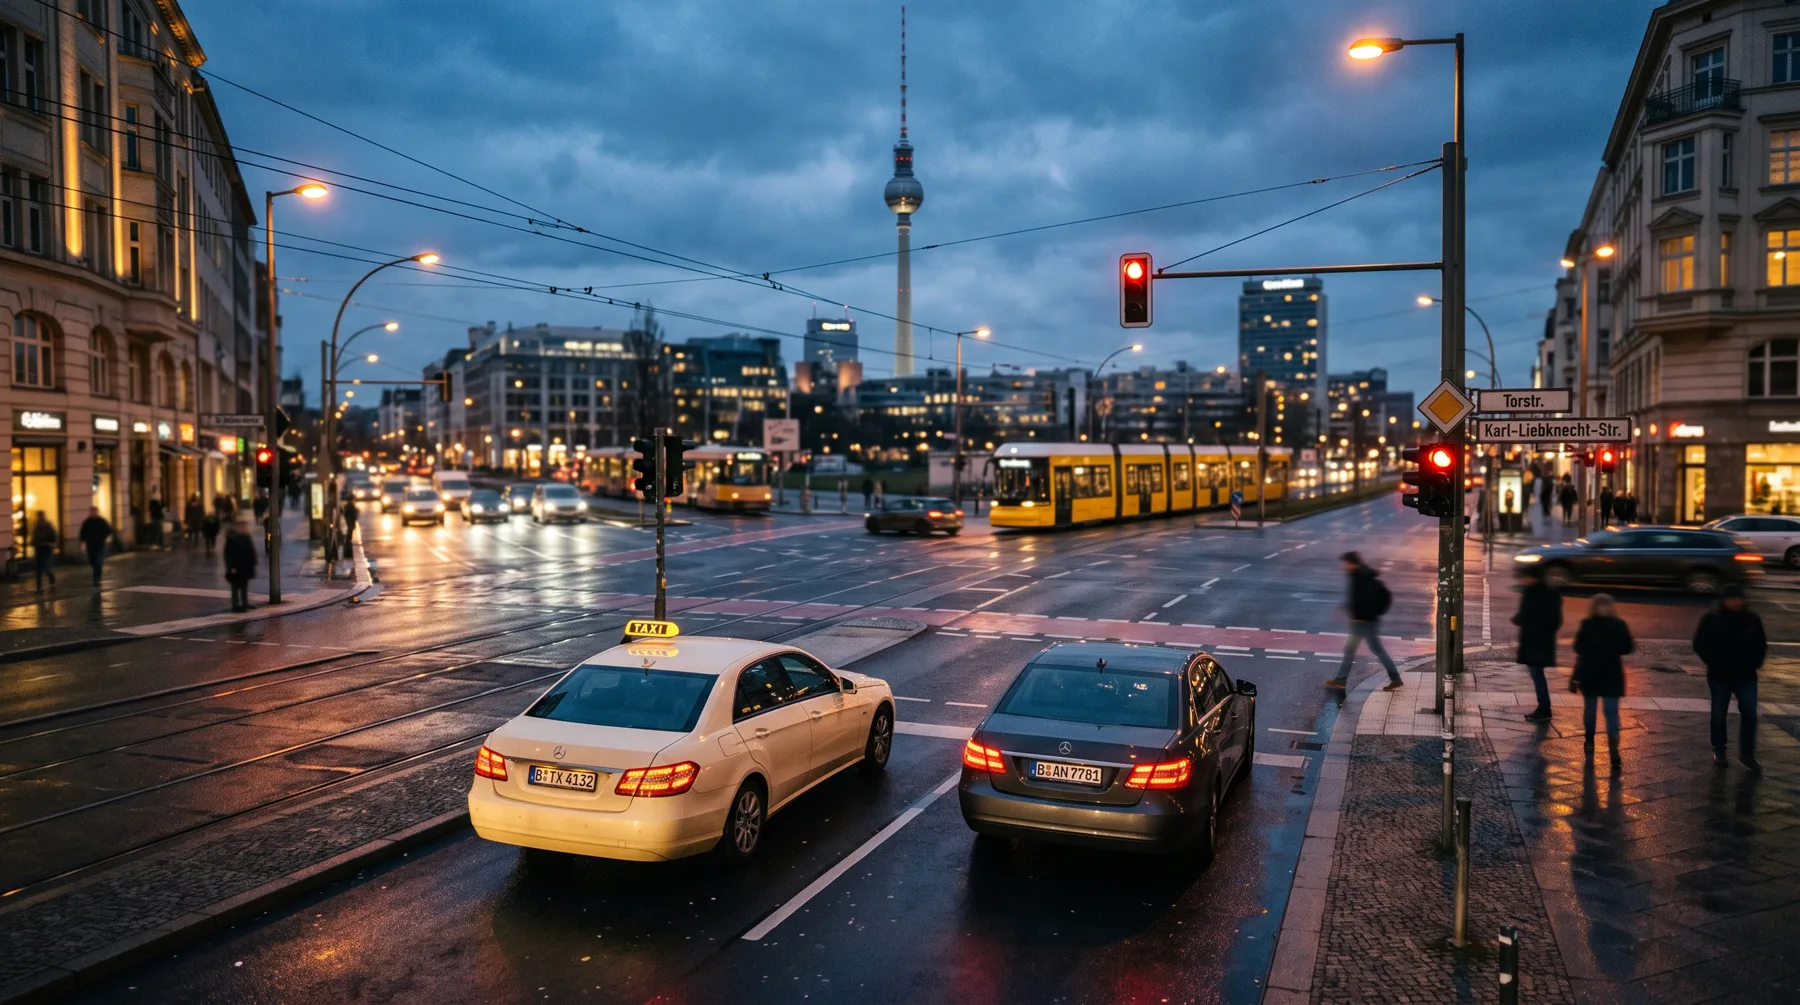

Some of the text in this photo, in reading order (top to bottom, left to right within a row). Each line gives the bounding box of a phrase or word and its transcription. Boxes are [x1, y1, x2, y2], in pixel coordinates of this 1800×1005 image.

[1503, 394, 1544, 407] Torstr.
[1484, 422, 1622, 438] Karl-Liebknecht-Str.
[634, 623, 663, 634] TAXI
[535, 769, 543, 782] B
[549, 770, 563, 785] TX
[565, 772, 594, 788] 4132
[1037, 764, 1045, 776] B
[1052, 765, 1069, 778] AN
[1071, 767, 1100, 782] 7781
